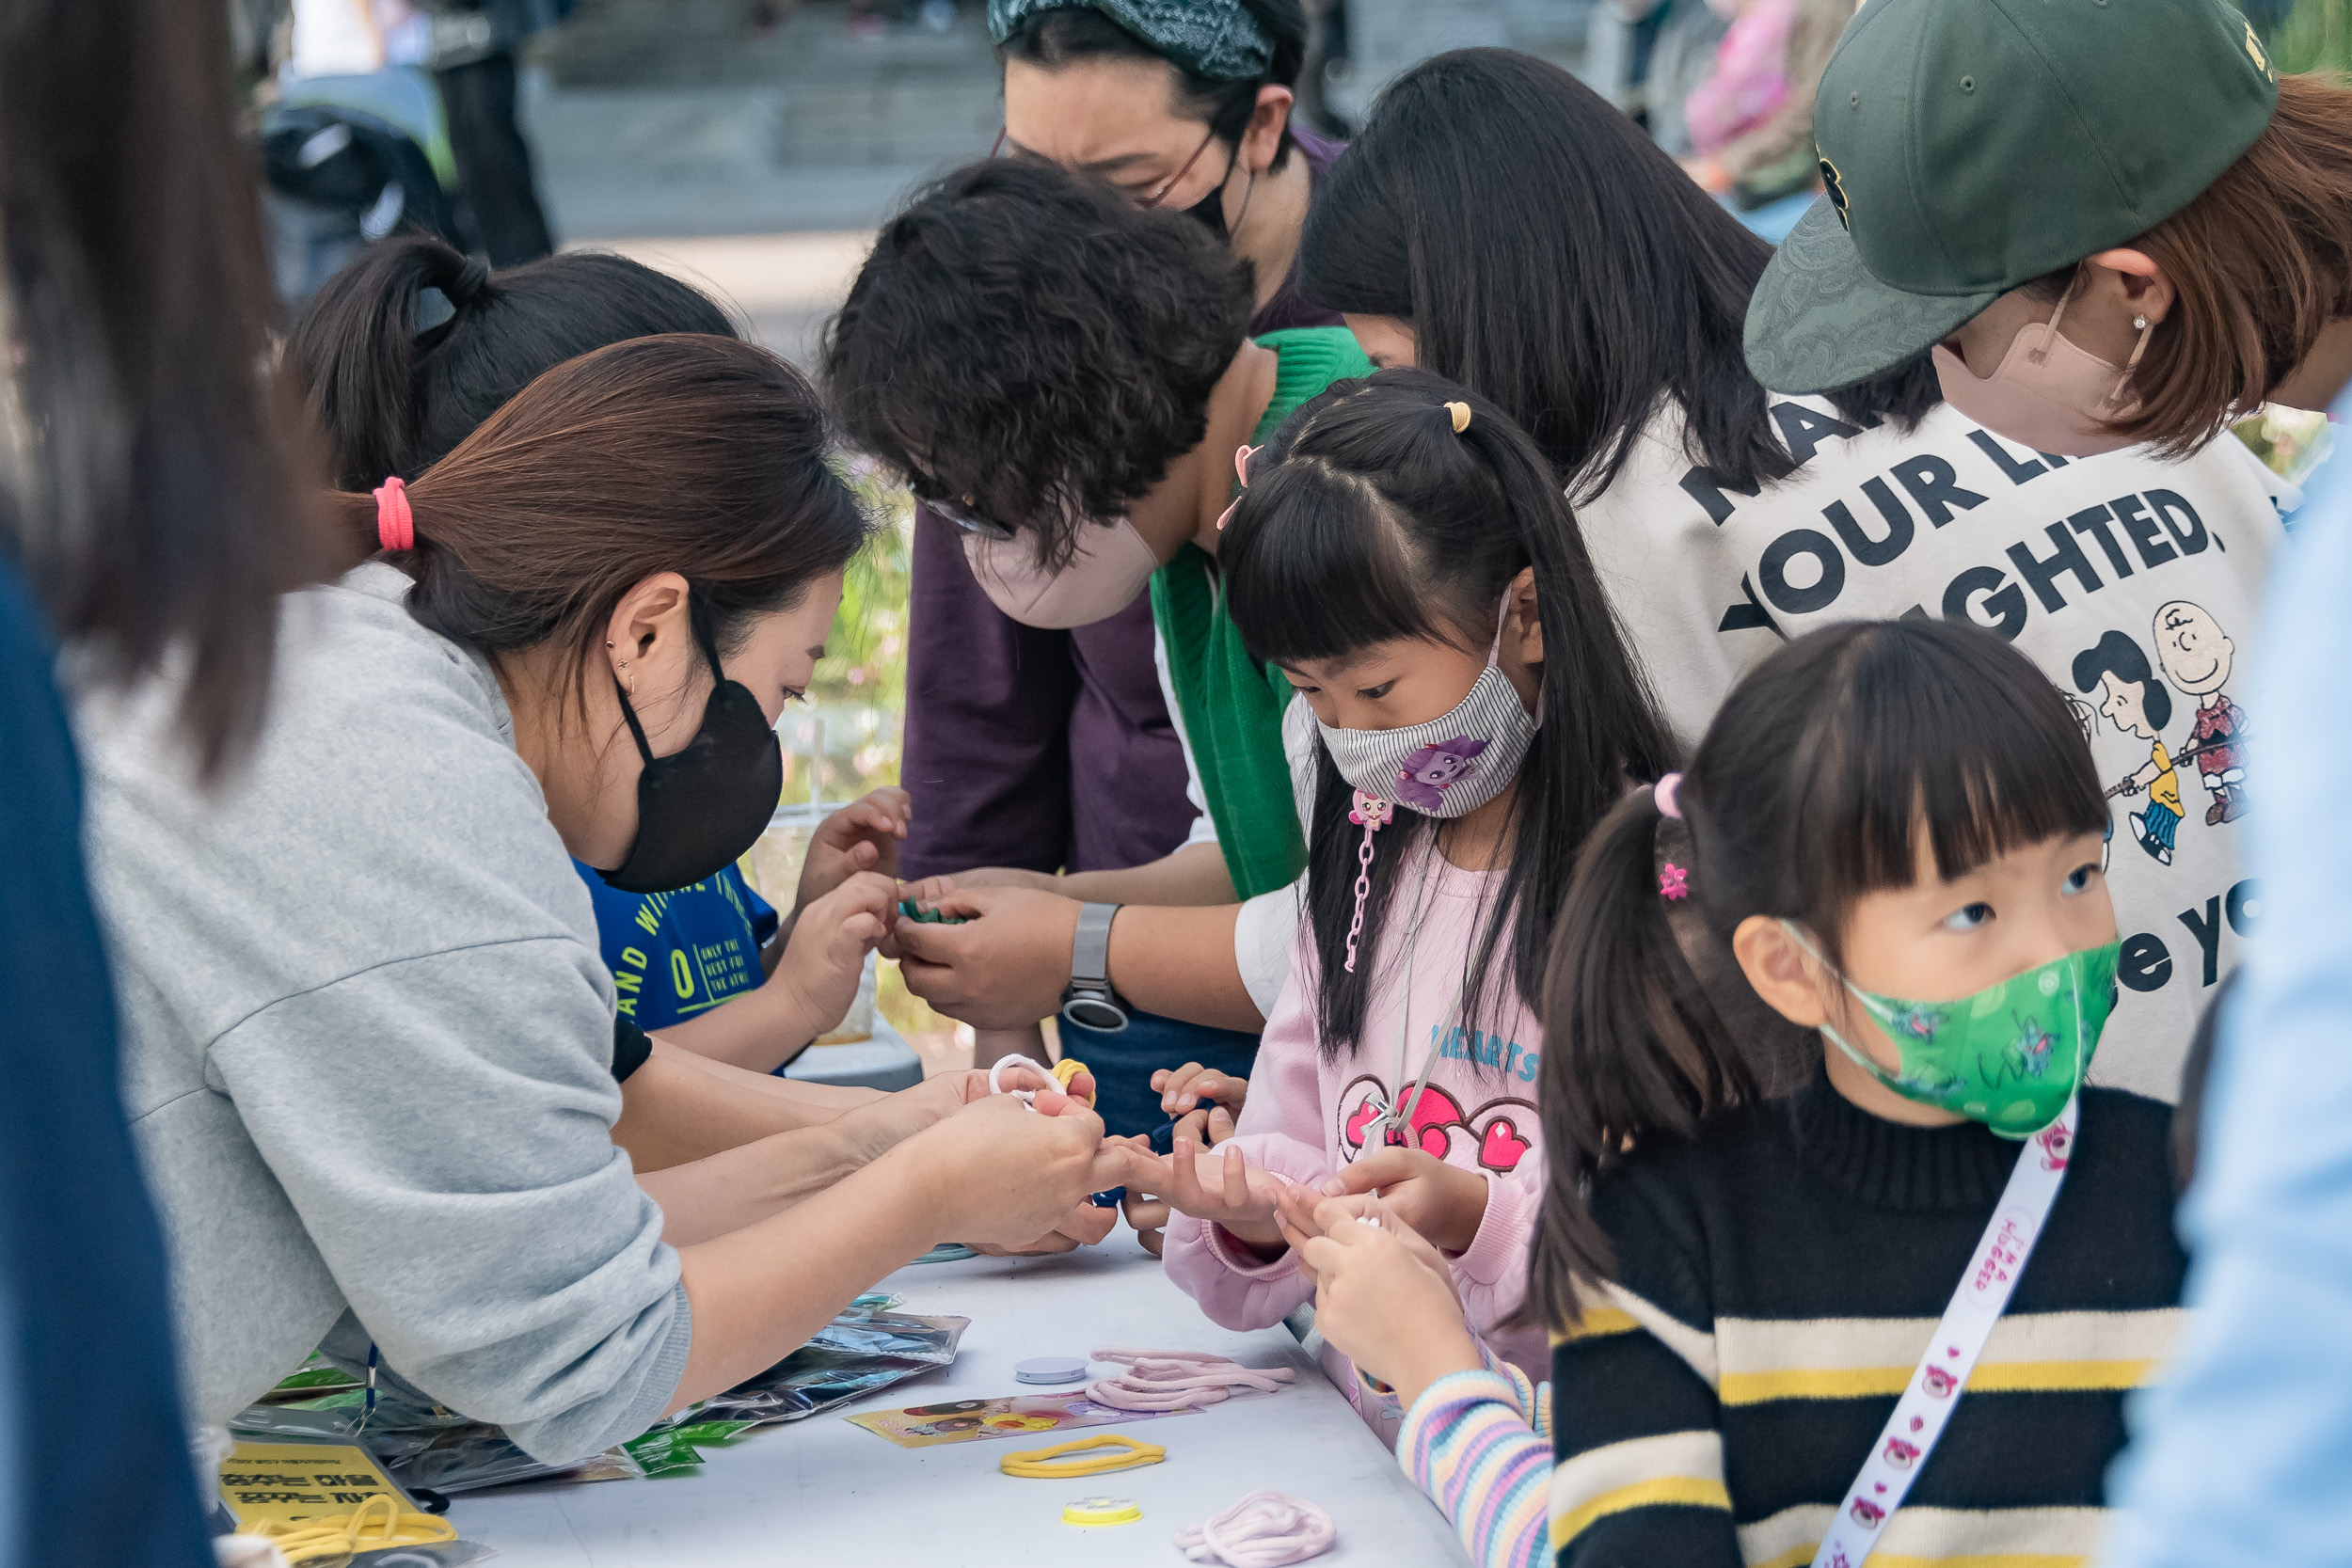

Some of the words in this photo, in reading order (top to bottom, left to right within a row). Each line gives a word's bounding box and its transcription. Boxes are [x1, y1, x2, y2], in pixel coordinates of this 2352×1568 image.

[1717, 453, 1990, 641] YOUR
[1898, 488, 2227, 641] GHTED,
[700, 943, 723, 961] ONLY
[705, 958, 728, 977] BEST
[710, 977, 728, 992] THE
[1431, 1024, 1540, 1083] HEARTS
[1974, 1217, 2017, 1291] HUGGER
[312, 1474, 379, 1486] 마을
[234, 1492, 327, 1504] 꿈꾸는
